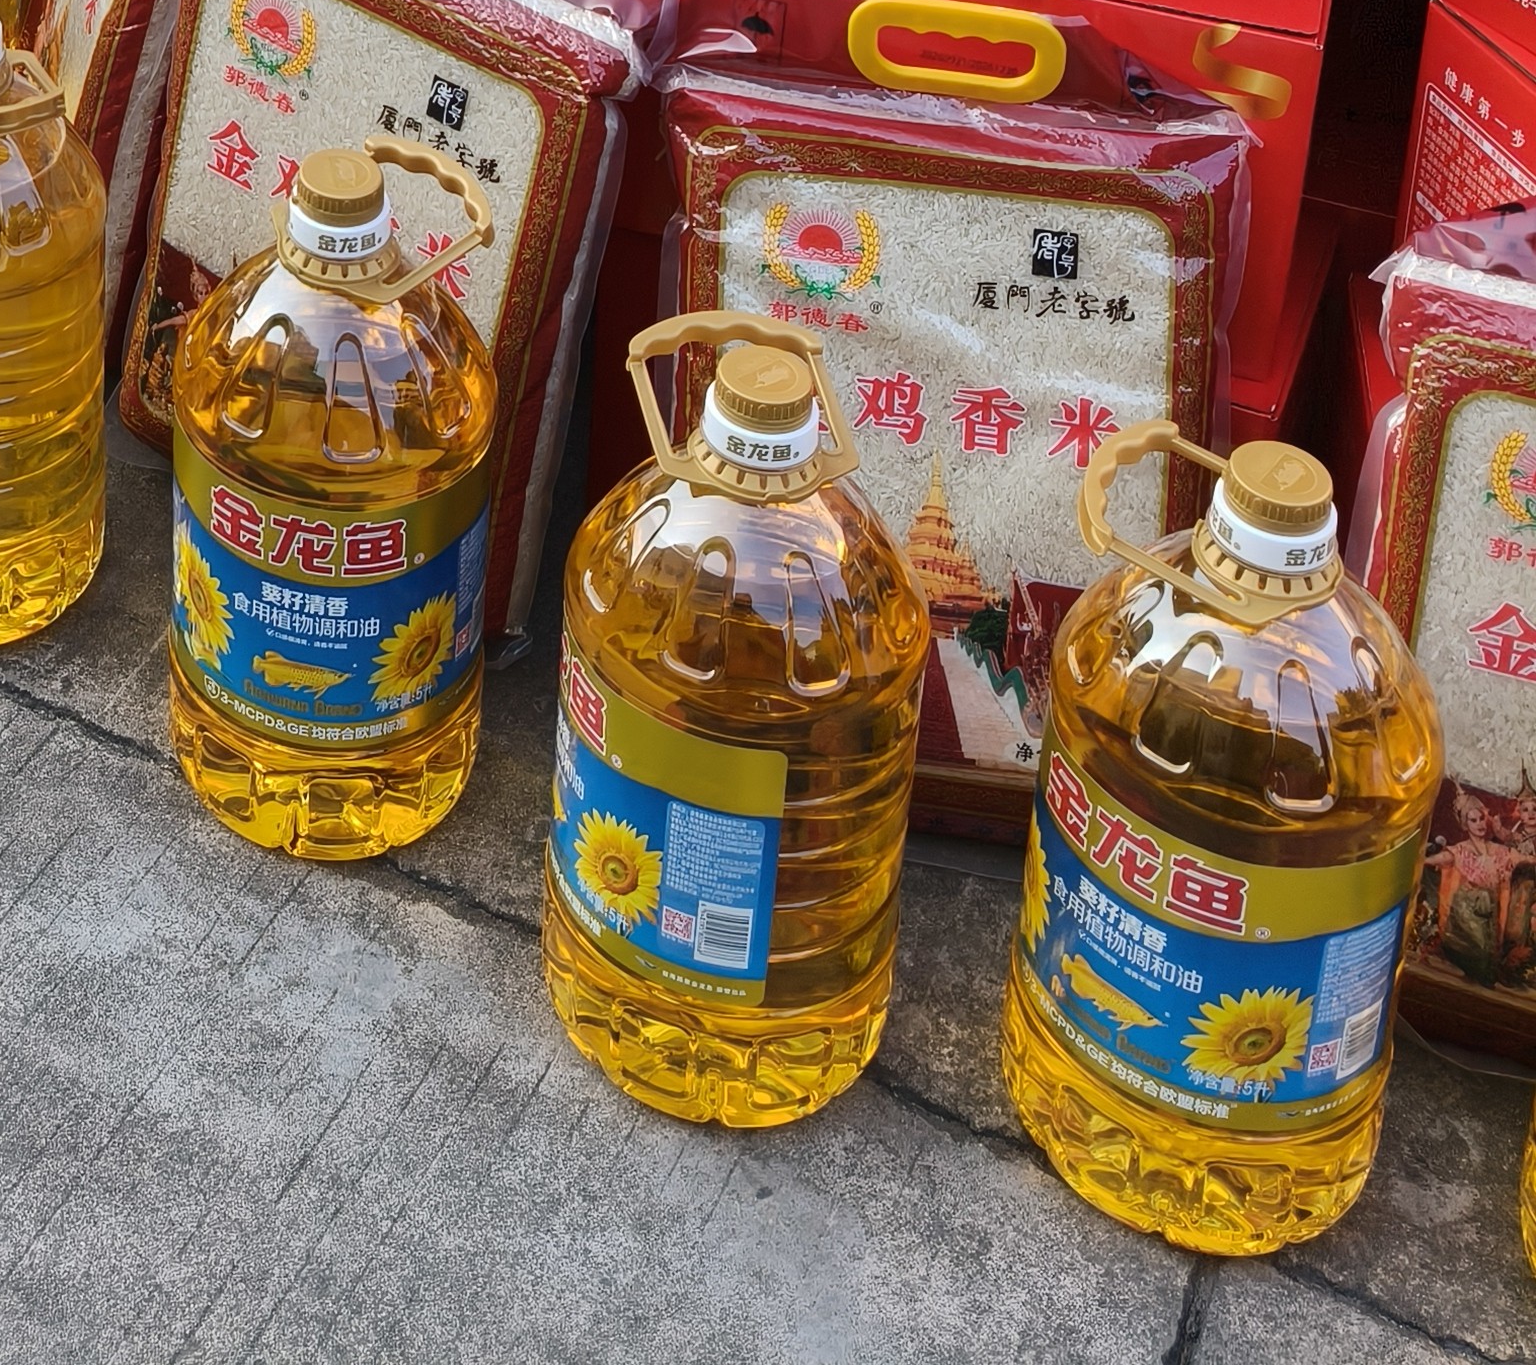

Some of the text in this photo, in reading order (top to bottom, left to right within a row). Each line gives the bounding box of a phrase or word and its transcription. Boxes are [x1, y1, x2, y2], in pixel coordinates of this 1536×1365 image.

[1444, 67, 1526, 148] 健康第一步
[317, 232, 378, 254] 金龙鱼
[726, 434, 794, 462] 金龙鱼
[816, 370, 1122, 469] 鸡香米
[210, 484, 407, 578] 金龙鱼
[232, 591, 380, 640] 食用植物调和油
[261, 581, 349, 617] 葵籽清香
[219, 689, 408, 741] 3-MCPD&GE 均符合欧盟标准
[1045, 751, 1249, 938] 金龙鱼
[1053, 875, 1204, 995] 食用植物调和油
[1078, 875, 1168, 954] 葵籽清香
[1110, 1060, 1230, 1120] 均符合欧盟标准
